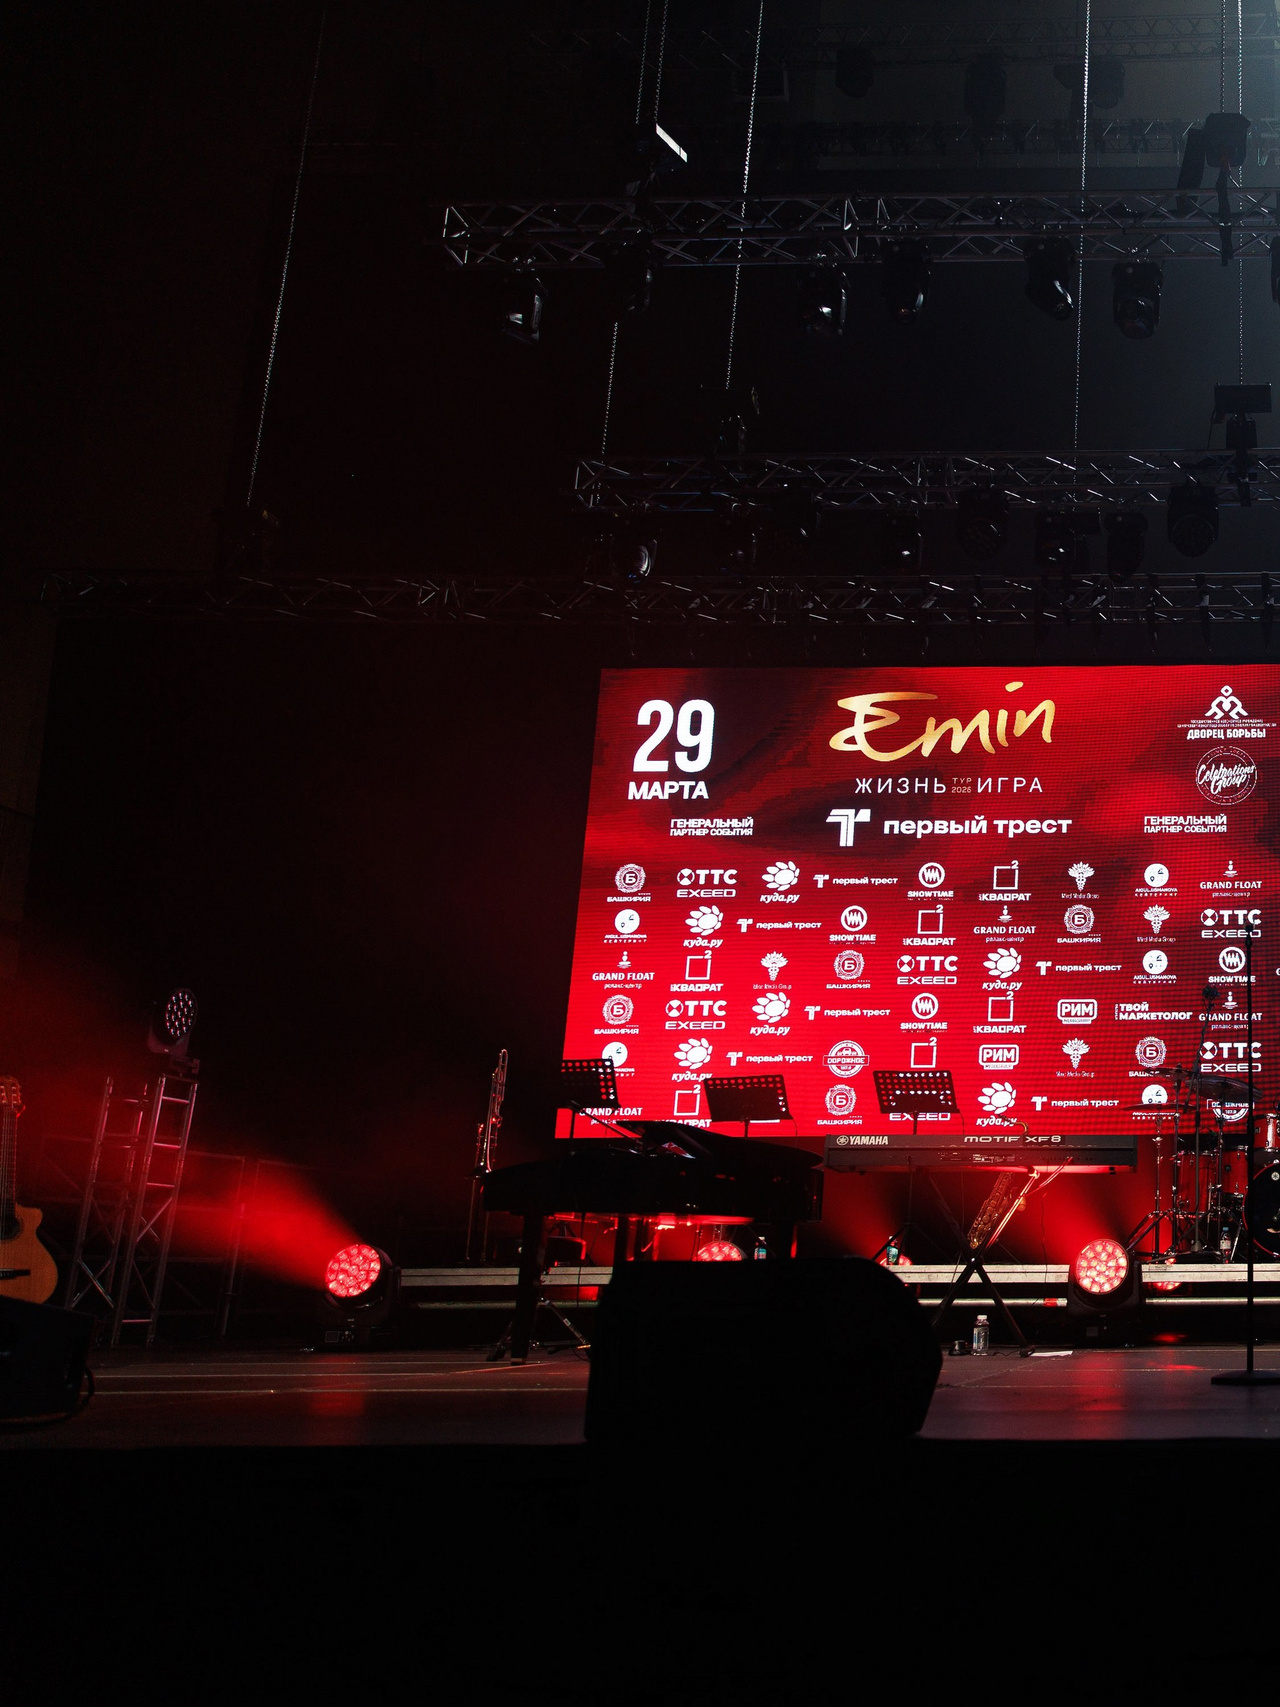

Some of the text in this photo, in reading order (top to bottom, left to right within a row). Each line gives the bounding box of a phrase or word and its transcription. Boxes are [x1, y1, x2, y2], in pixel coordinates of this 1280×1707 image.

[633, 699, 714, 772] 29
[1187, 728, 1266, 739] ДВОРЕЦ БОРЬБЫ
[1198, 763, 1255, 784] Celebrations
[855, 778, 946, 793] ЖИЗНЬ
[978, 778, 1042, 792] ИГРА
[1211, 774, 1247, 794] Group
[628, 781, 709, 799] МАРТА
[671, 817, 753, 829] ГЕНЕРАЛЬНЫЙ
[1144, 814, 1227, 826] ГЕНЕРАЛЬНЫЙ
[884, 816, 1072, 838] первый трест
[1144, 825, 1226, 834] ПАРТНЕР СОБЫТИЯ
[671, 828, 753, 837] ПАРТНЕР СОБЫТИЯ
[832, 876, 899, 886] первый трест
[1199, 880, 1263, 890] GRAND FLOAT
[676, 888, 737, 898] EXEED
[906, 890, 954, 898] SHOWTIME
[760, 893, 800, 904] куда.ру
[755, 921, 822, 930] первый трест
[973, 925, 1037, 934] GRAND FLOAT
[684, 937, 724, 948] куда.ру
[829, 933, 877, 942] SHOWTIME
[1055, 963, 1123, 973] первый трест
[591, 971, 656, 981] GRAND FLOAT
[896, 975, 958, 985] EXEED
[982, 980, 1022, 990] куда.ру
[1061, 1004, 1093, 1016] РИМ
[1120, 1001, 1150, 1012] ТВОЙ
[823, 1008, 891, 1018] первый трест
[1118, 1011, 1193, 1021] МАРКЕТОЛОГ
[664, 1020, 726, 1030] EXEED
[750, 1025, 790, 1035] куда.ру
[899, 1021, 948, 1030] SHOWTIME
[745, 1054, 814, 1064] первый трест
[983, 1049, 1015, 1061] РИМ
[1051, 1098, 1120, 1108] первый трест
[850, 1136, 888, 1145] YAMAHA
[964, 1135, 1061, 1144] MOTIF XF8
